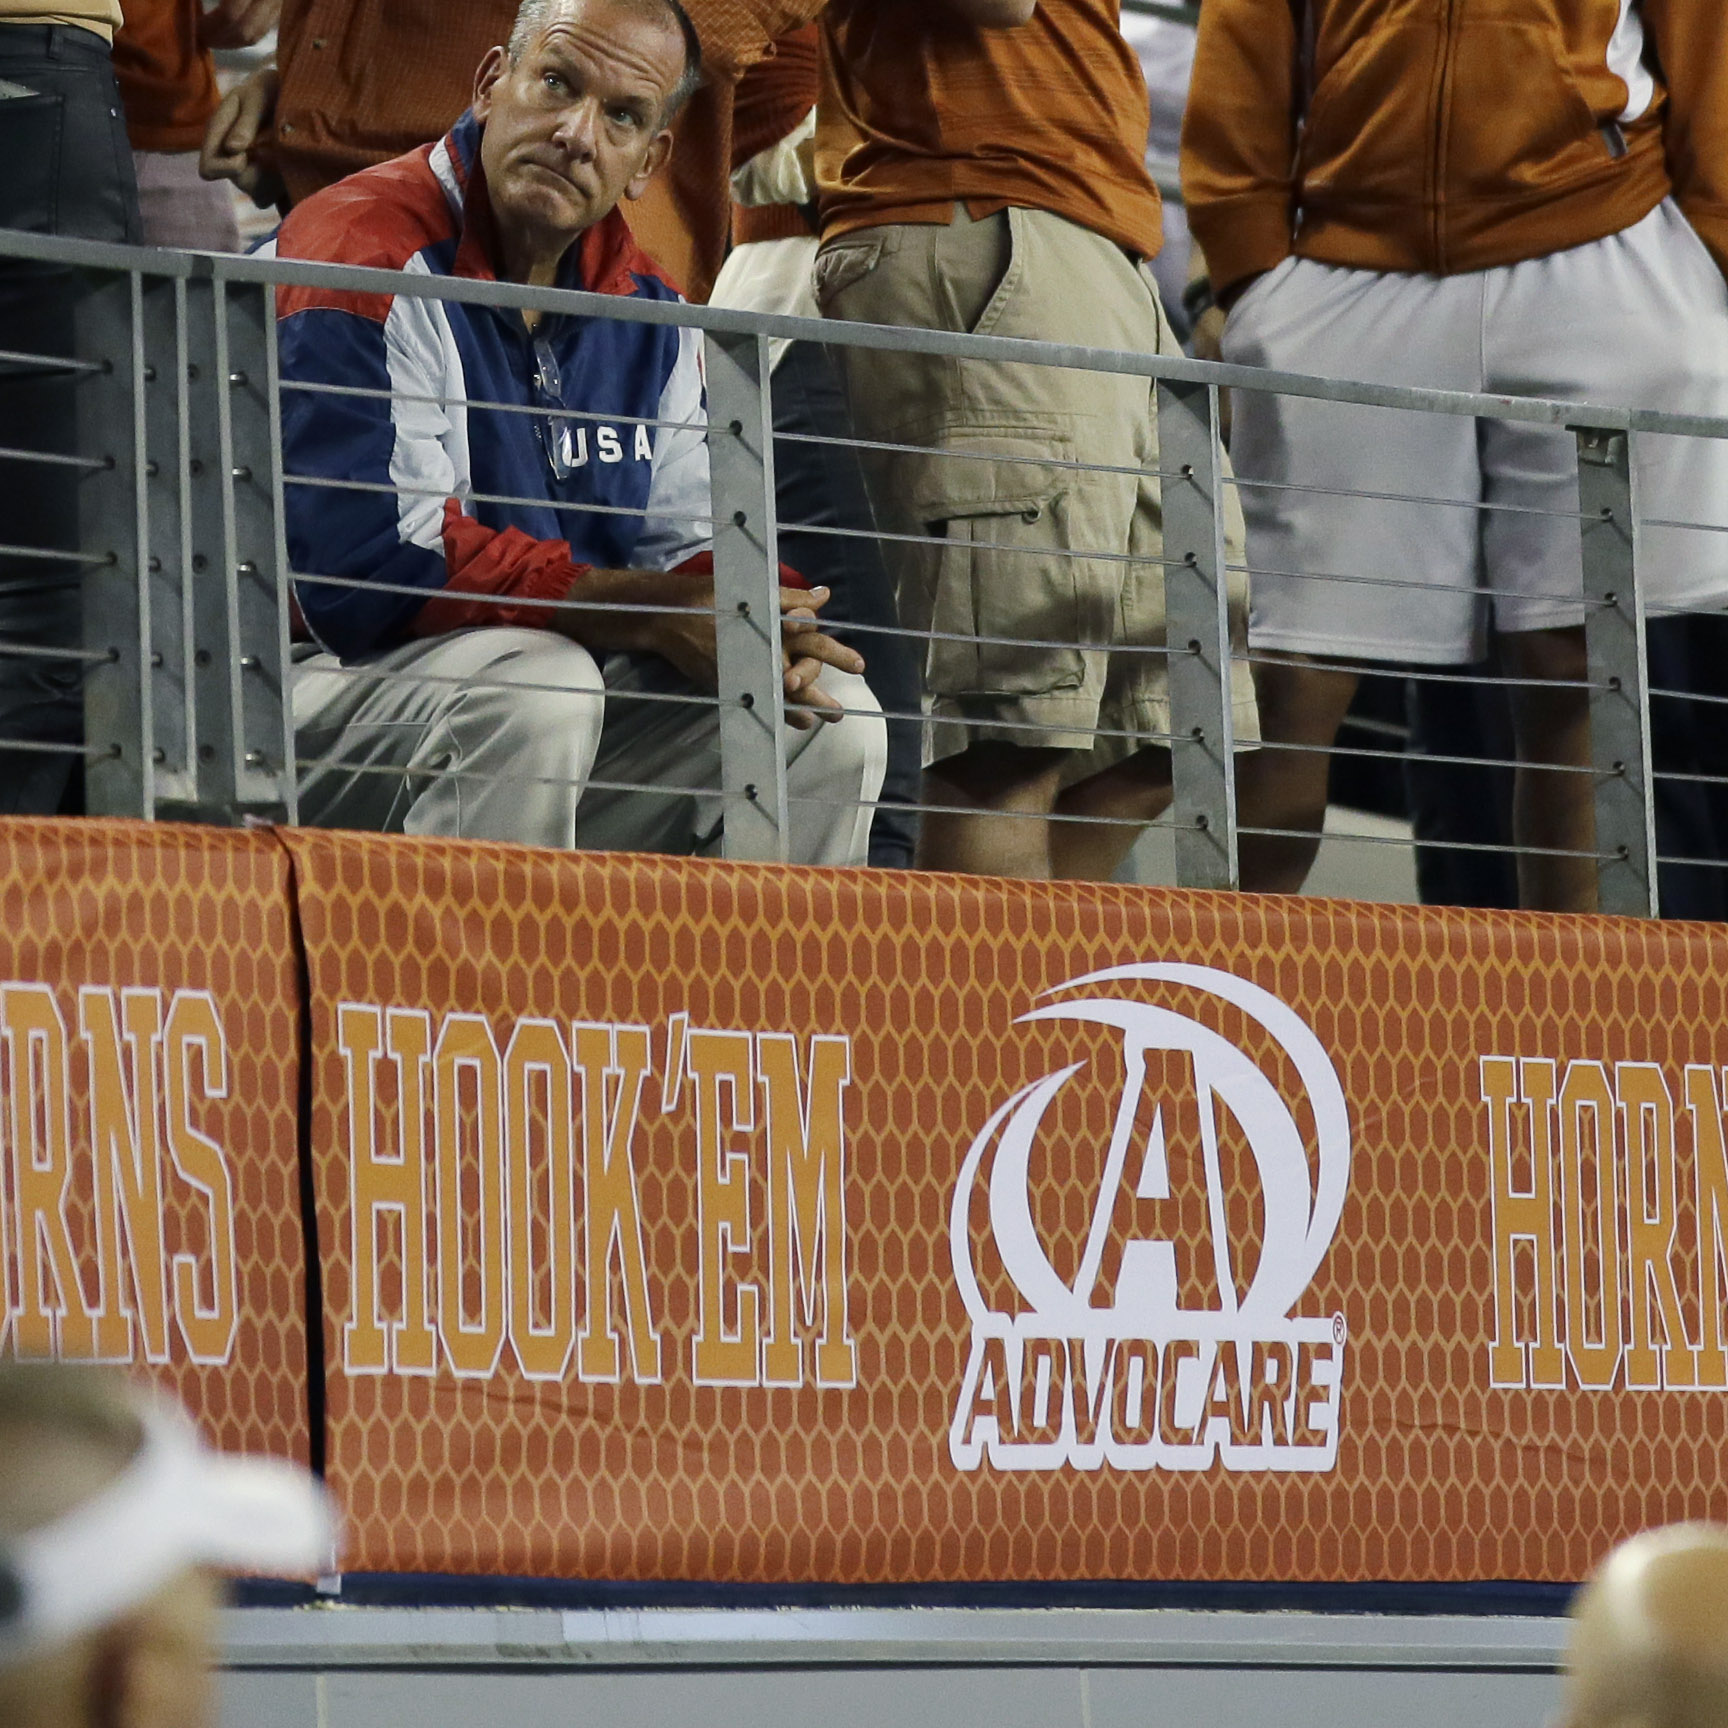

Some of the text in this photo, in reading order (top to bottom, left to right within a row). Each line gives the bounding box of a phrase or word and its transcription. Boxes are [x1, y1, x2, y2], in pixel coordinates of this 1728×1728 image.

[561, 424, 652, 467] USA
[337, 1001, 857, 1389] HOOK'EM
[954, 1326, 1337, 1459] ADVOCARE
